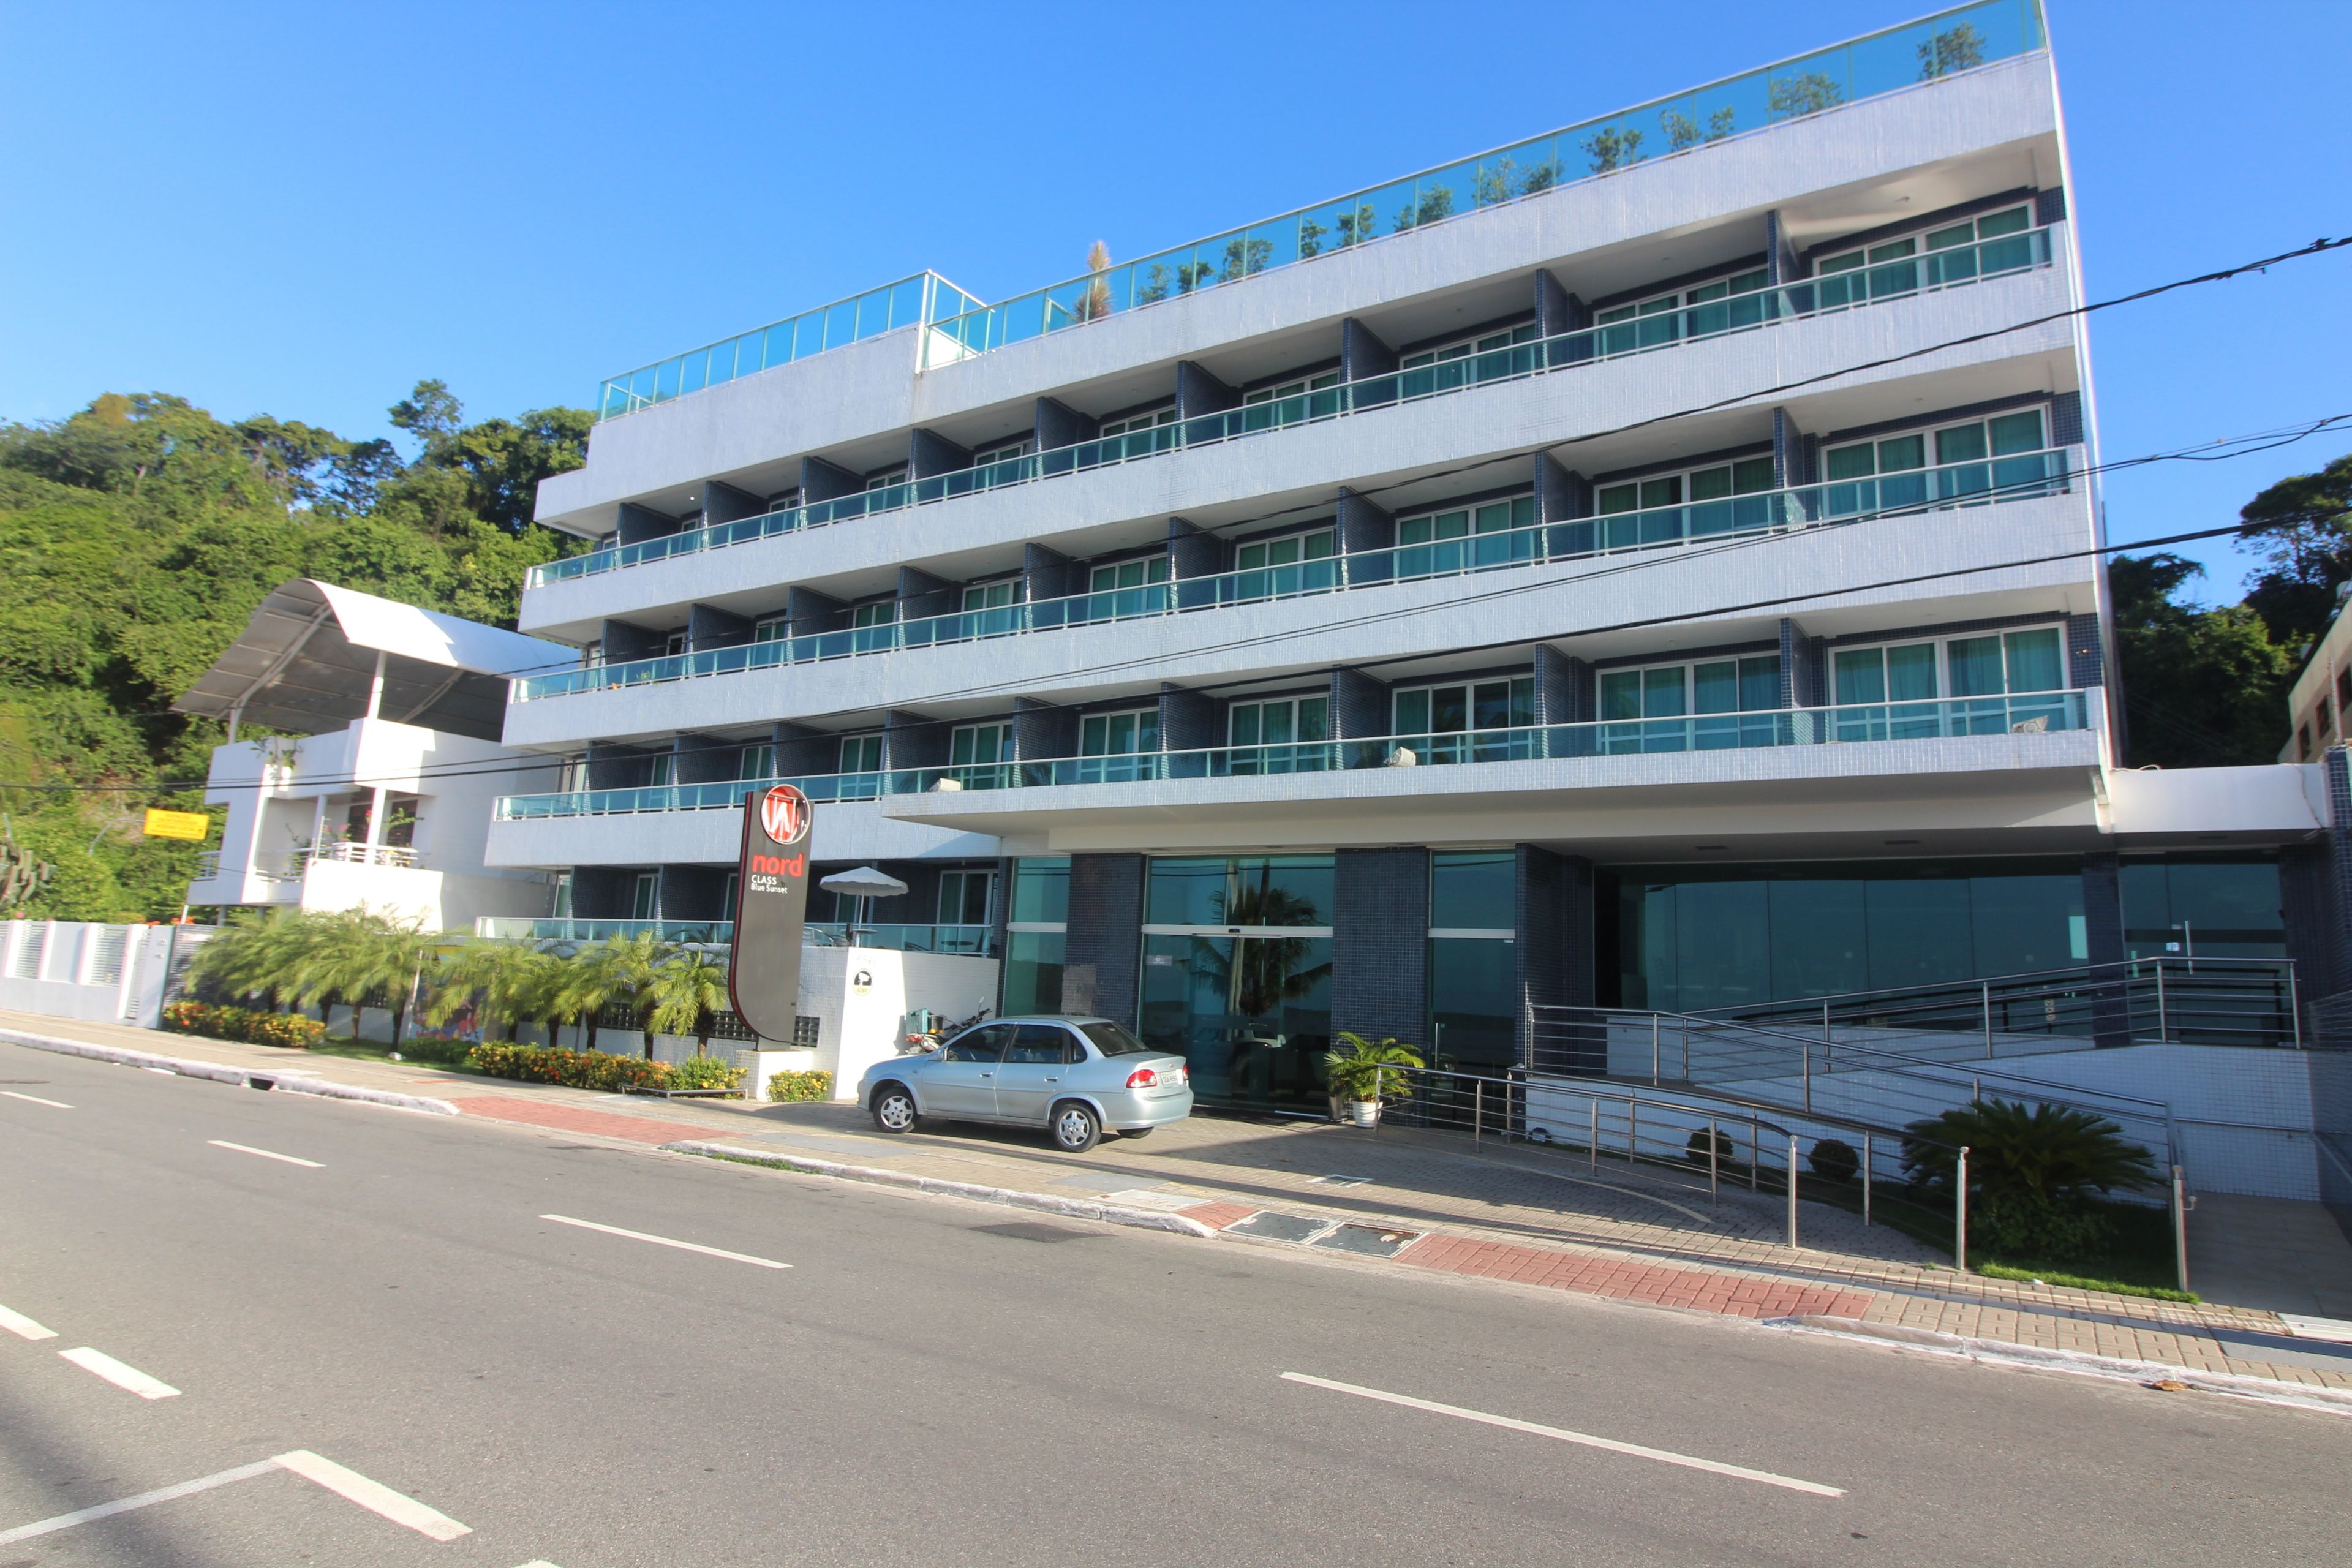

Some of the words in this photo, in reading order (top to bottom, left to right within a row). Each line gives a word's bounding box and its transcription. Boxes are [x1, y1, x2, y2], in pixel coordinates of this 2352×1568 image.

[752, 853, 804, 877] nord
[751, 875, 777, 885] CLASS
[751, 883, 765, 892] Blue
[766, 884, 788, 894] Sunset
